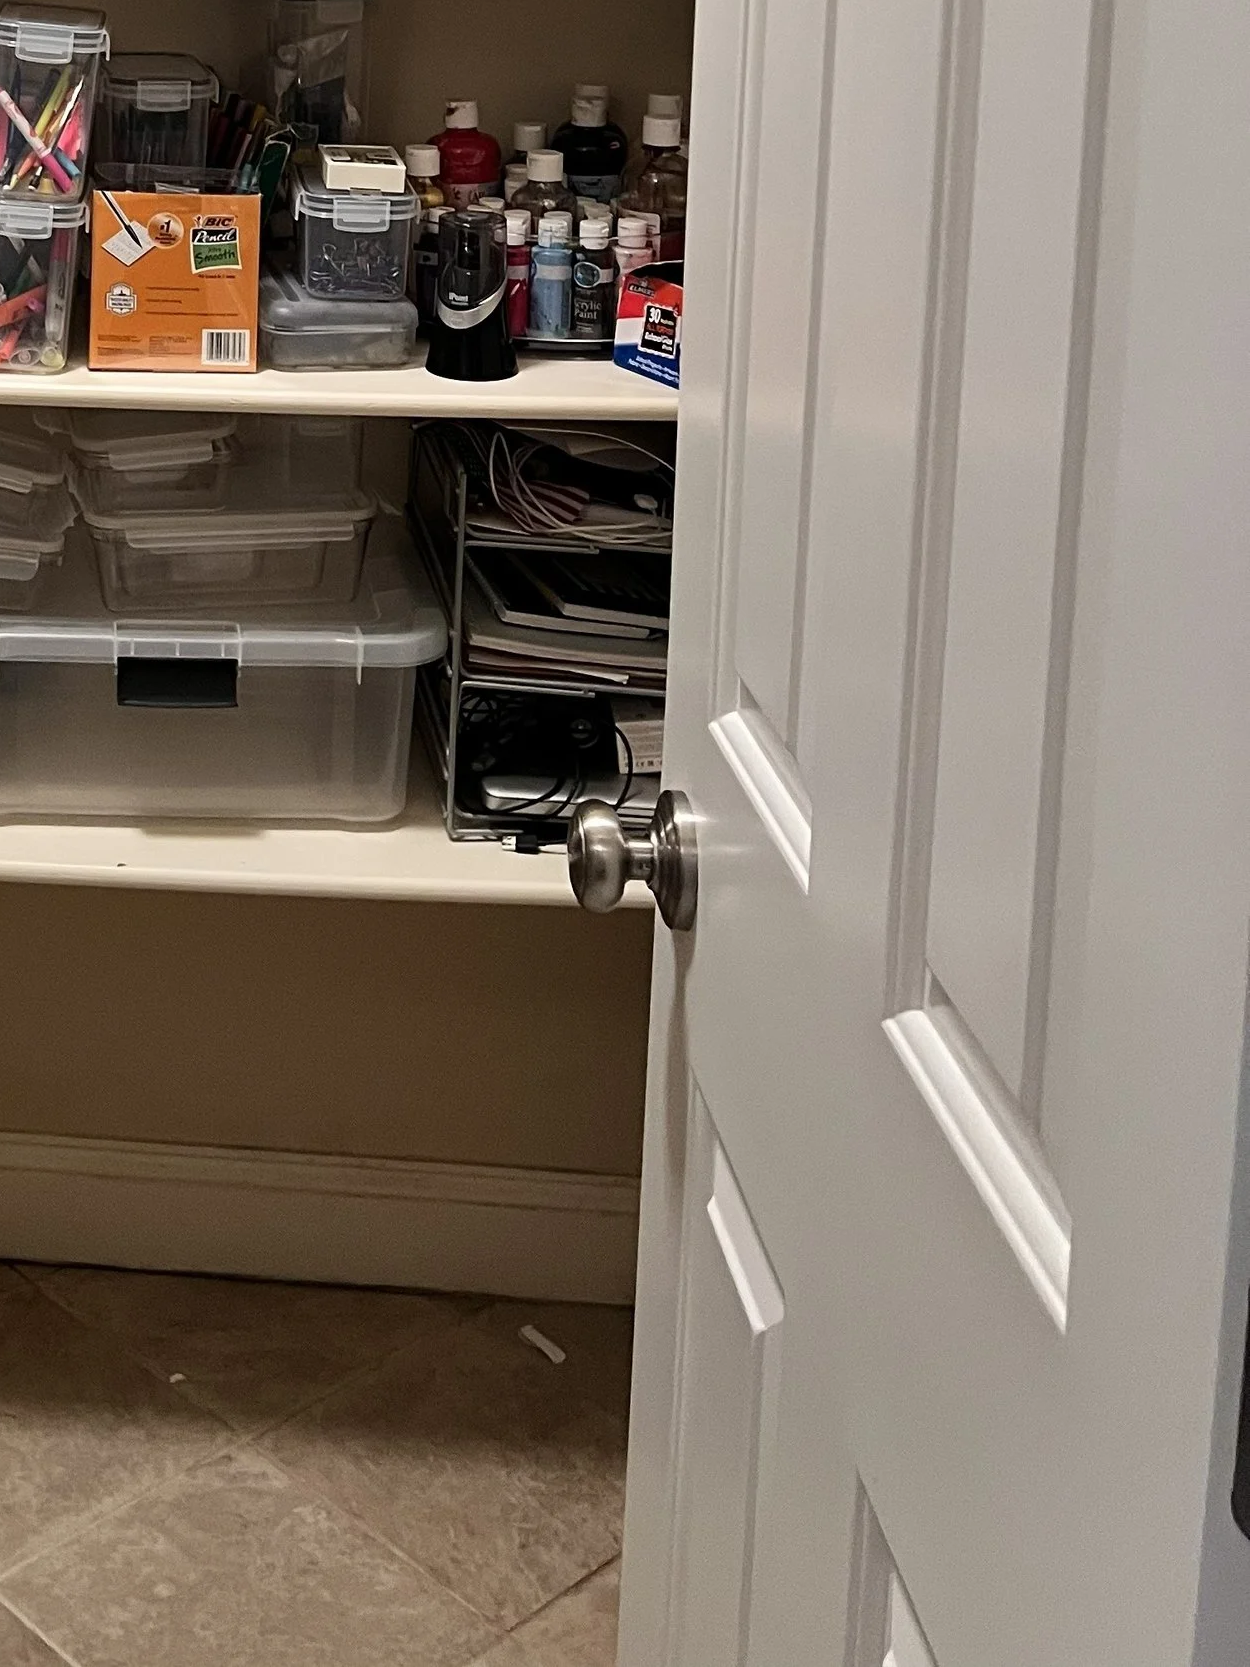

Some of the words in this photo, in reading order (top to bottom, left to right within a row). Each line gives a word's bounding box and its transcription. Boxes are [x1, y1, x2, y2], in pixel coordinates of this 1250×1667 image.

[204, 216, 233, 228] BIC
[192, 229, 236, 243] Pencil
[194, 251, 236, 265] Smooth
[648, 307, 661, 324] 30
